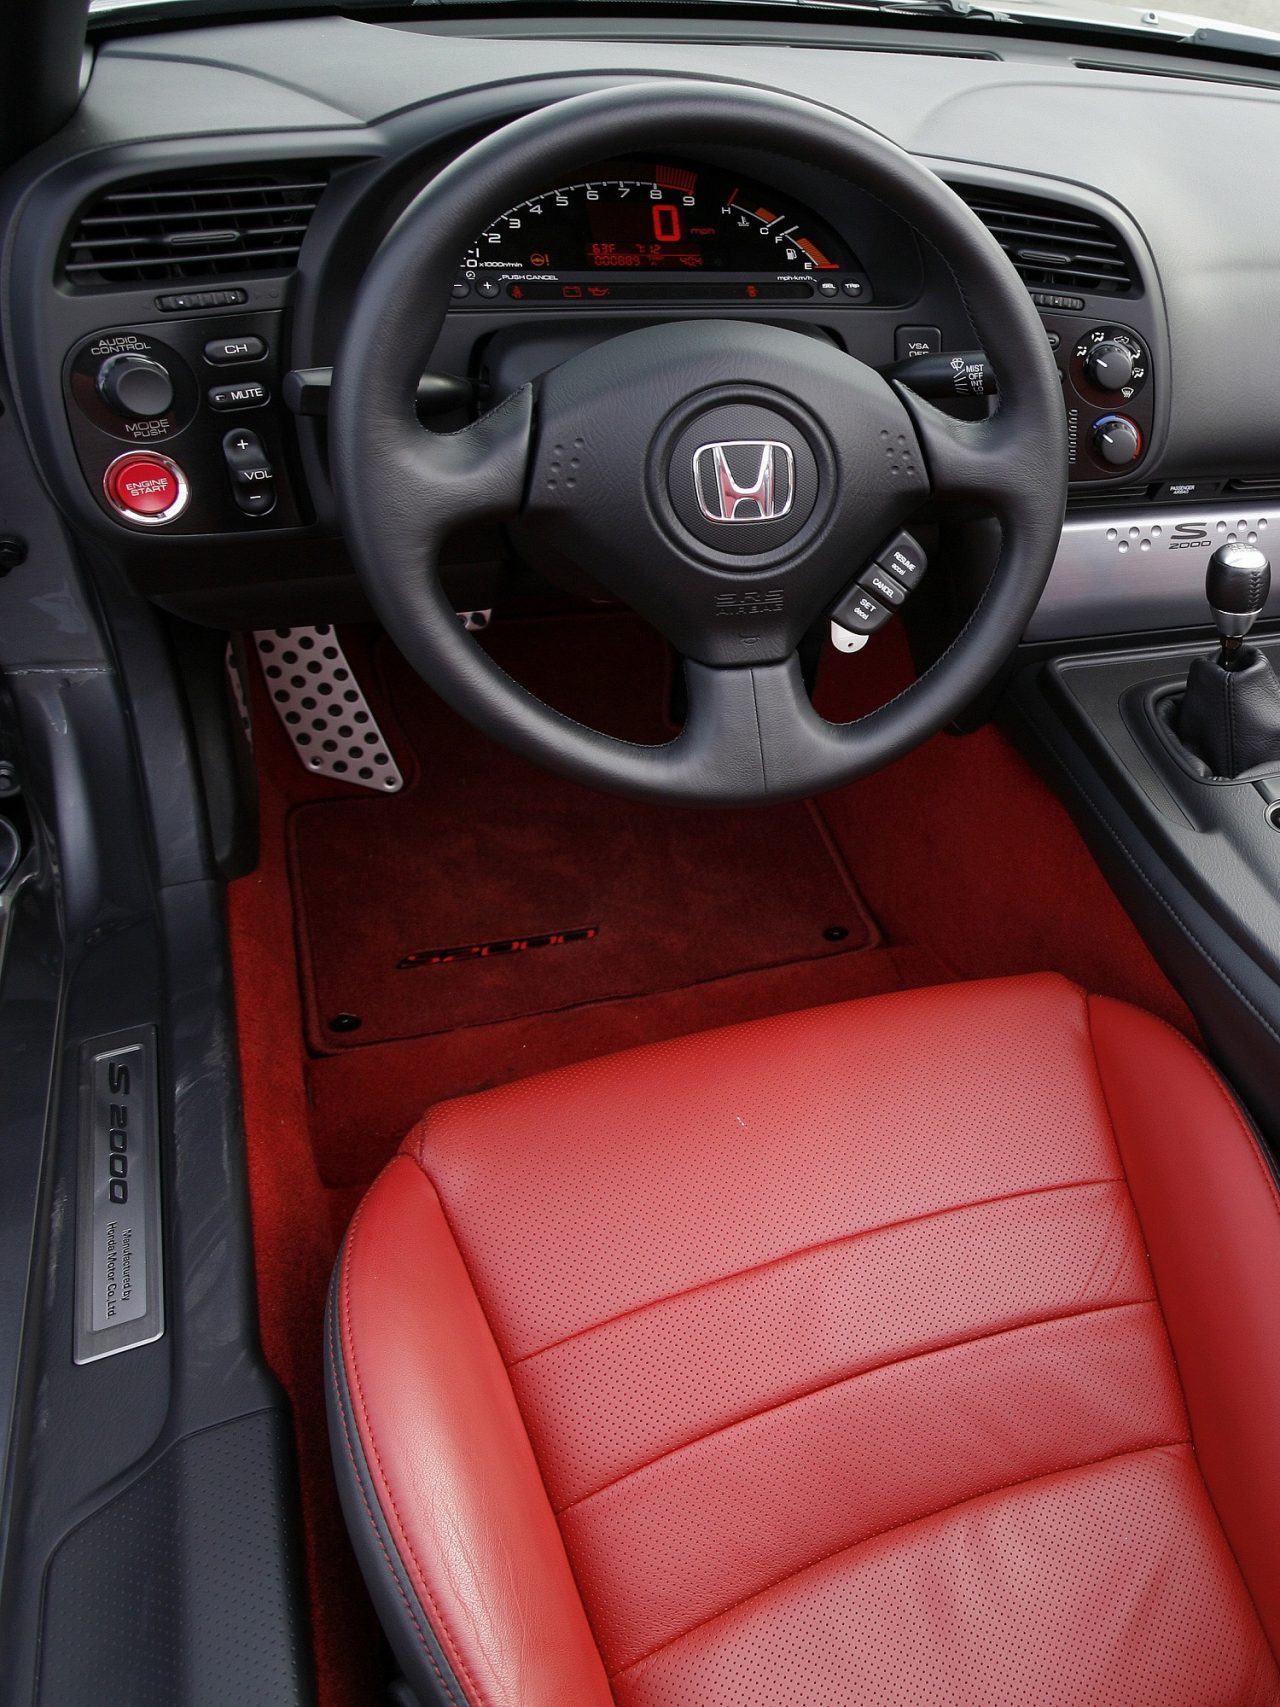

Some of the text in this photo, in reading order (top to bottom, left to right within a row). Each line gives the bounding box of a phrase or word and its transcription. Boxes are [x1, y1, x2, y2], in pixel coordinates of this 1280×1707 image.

[587, 190, 599, 200] 6
[619, 188, 630, 198] 7
[649, 190, 662, 200] 8
[556, 196, 569, 206] 5
[682, 196, 695, 206] 9
[529, 204, 543, 215] 4
[721, 206, 731, 215] H
[509, 218, 521, 229] 3
[652, 204, 681, 242] 0
[759, 227, 769, 235] C
[488, 233, 501, 243] 2
[775, 236, 783, 244] F
[466, 259, 478, 268] 0
[804, 262, 813, 270] E
[98, 336, 138, 347] AUDIO
[908, 342, 930, 350] VSA
[91, 342, 151, 355] CONTROL
[224, 343, 248, 354] CH
[966, 363, 984, 373] MIST
[968, 372, 984, 380] OFF
[970, 379, 984, 387] INT
[231, 387, 263, 400] MUTE
[125, 418, 170, 433] MODE
[133, 427, 167, 438] PUSH
[244, 470, 273, 481] VOL
[126, 477, 169, 491] ENGINE
[130, 484, 167, 497] START
[1170, 522, 1208, 540] S
[1168, 540, 1212, 550] 2000
[893, 551, 916, 572] RESUME
[872, 577, 895, 599] CANCEL
[859, 598, 877, 613] SET
[108, 1062, 131, 1205] S 2000
[107, 1221, 118, 1251] Honda
[107, 1251, 117, 1281] Motor
[120, 1228, 132, 1301] Manufactured by
